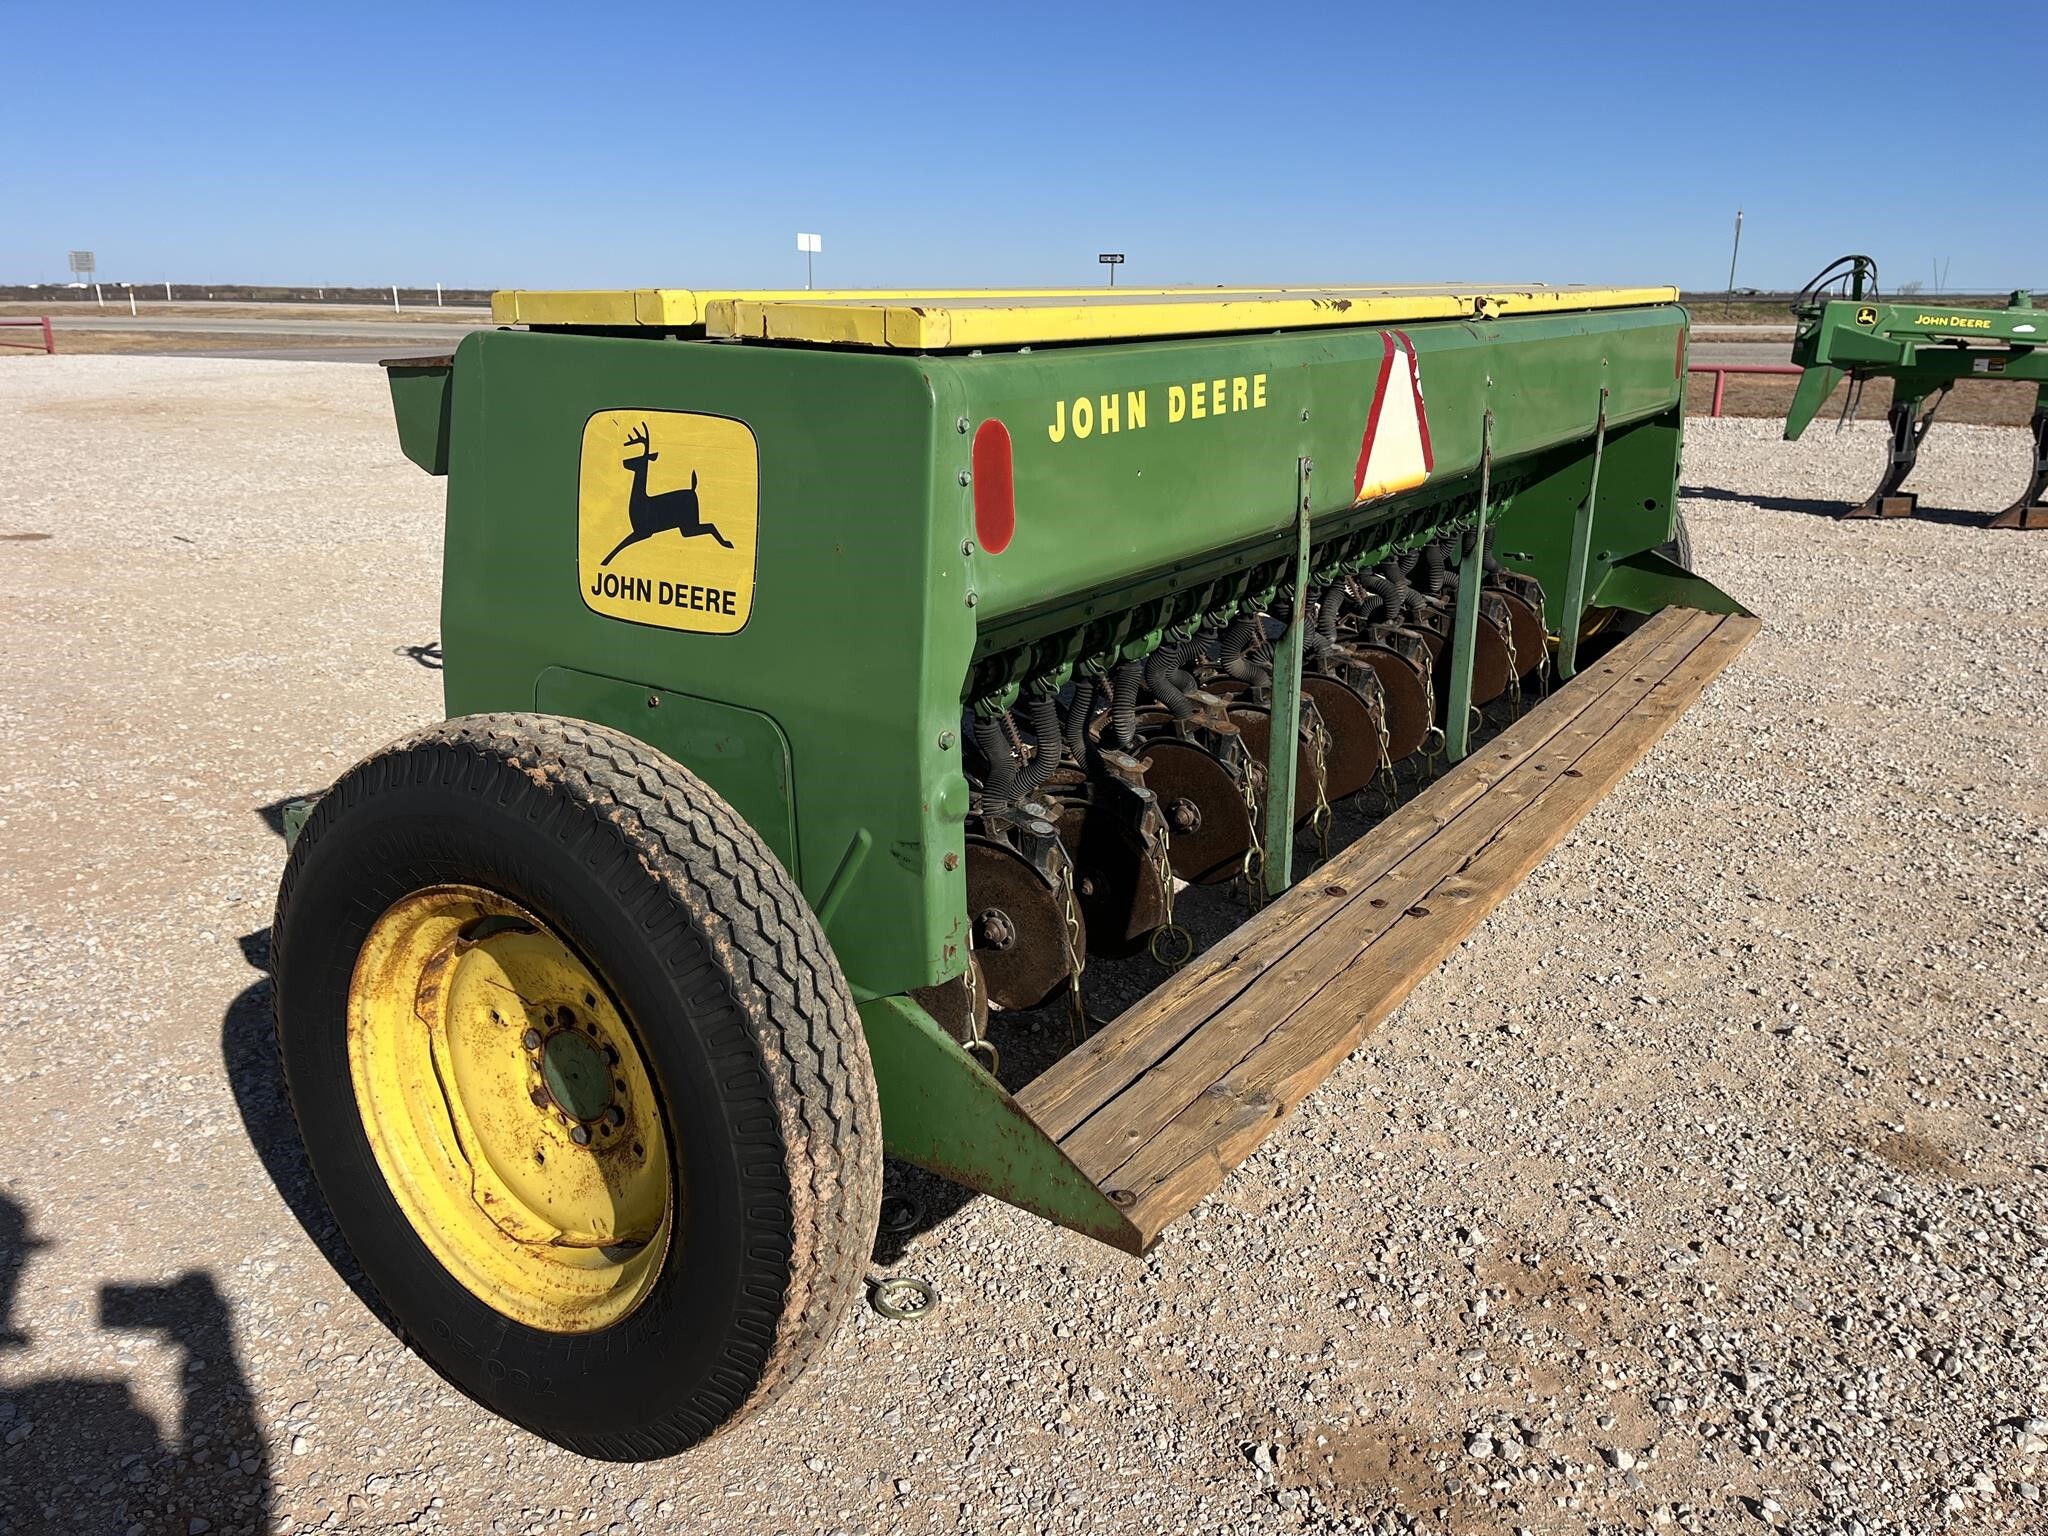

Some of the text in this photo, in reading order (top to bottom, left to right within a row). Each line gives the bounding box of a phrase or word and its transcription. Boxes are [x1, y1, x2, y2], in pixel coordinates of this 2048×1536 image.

[1914, 314, 1992, 329] JOHN DEERE
[1048, 373, 1267, 443] JOHN DEERE
[591, 572, 737, 616] JOHN DEERE
